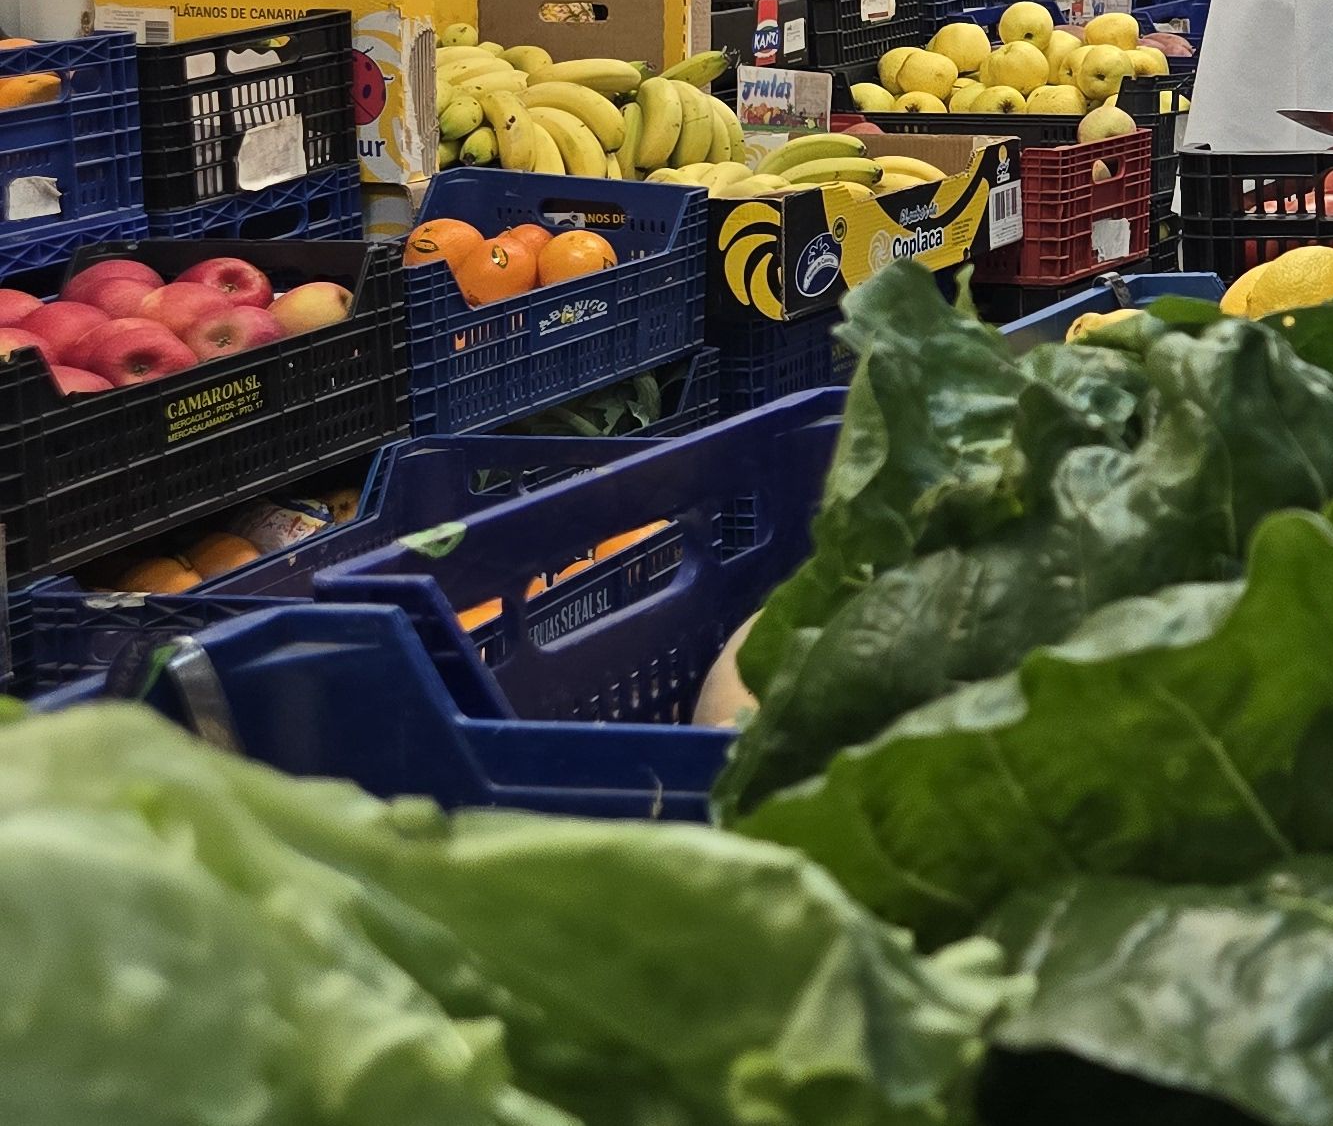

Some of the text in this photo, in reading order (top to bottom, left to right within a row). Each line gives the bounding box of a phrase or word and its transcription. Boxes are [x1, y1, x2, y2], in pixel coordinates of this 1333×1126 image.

[231, 7, 247, 19] DE
[250, 8, 306, 21] CANARIA
[892, 226, 944, 259] Coplaca
[539, 299, 608, 331] ABANICO
[168, 412, 235, 443] MERCASALAMANCA
[560, 592, 596, 631] SERAL
